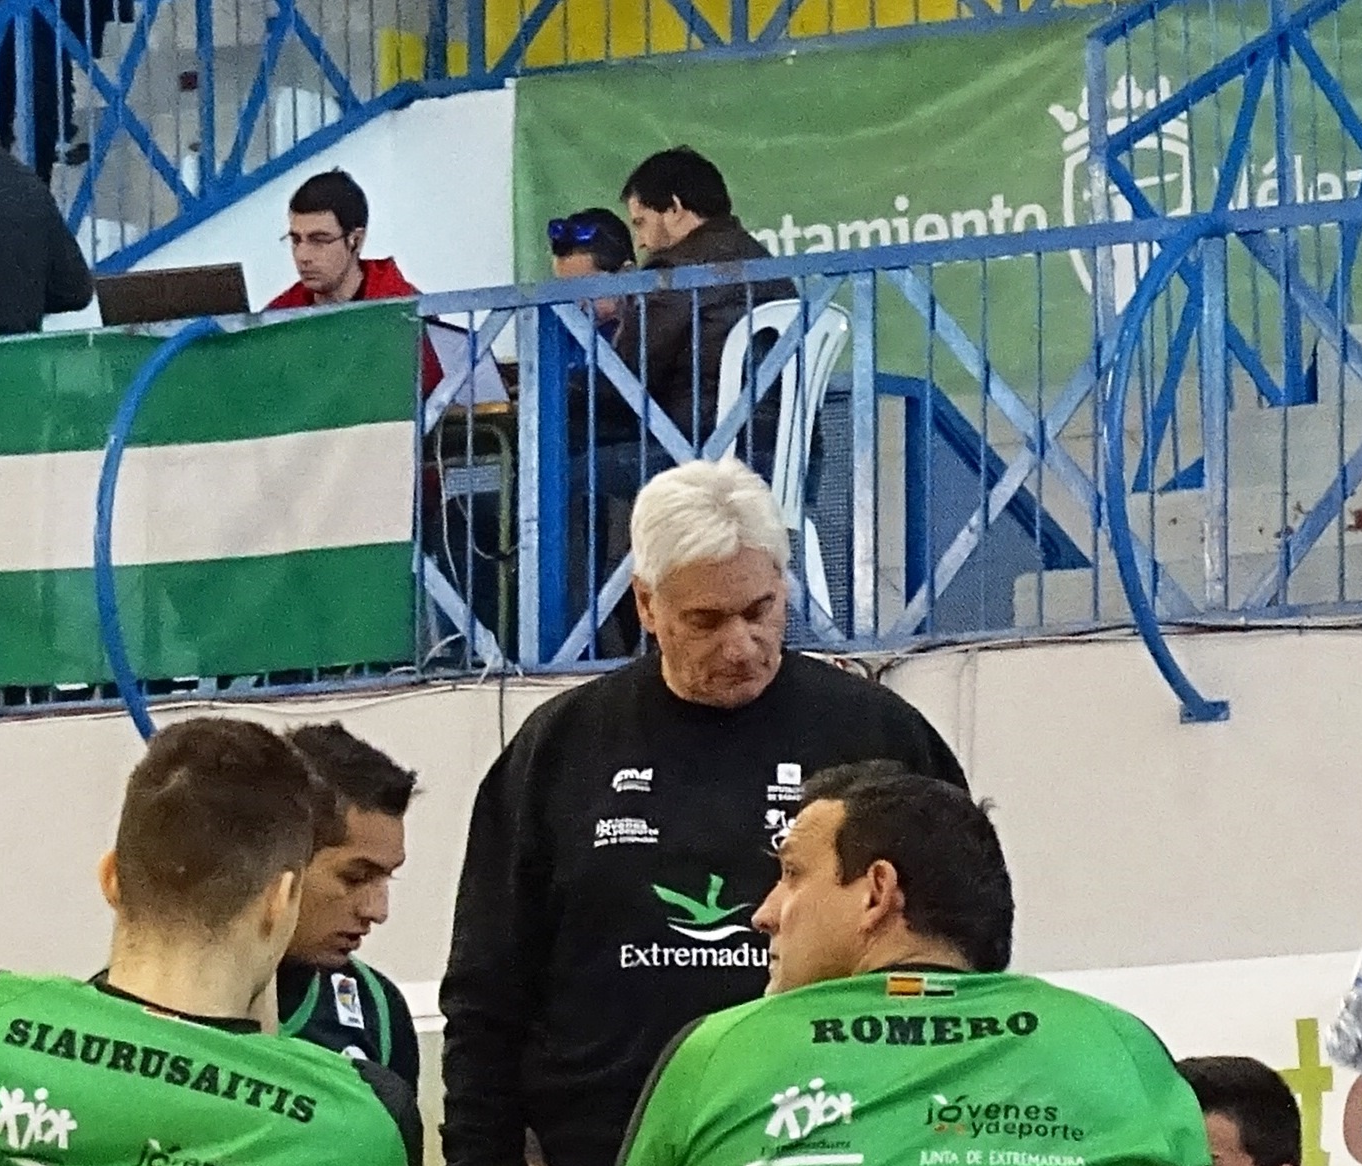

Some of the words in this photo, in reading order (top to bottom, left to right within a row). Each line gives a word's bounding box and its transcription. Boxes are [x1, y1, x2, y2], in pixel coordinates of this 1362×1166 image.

[810, 1011, 1039, 1046] ROMERO
[3, 1017, 318, 1125] SIAURUSAITIS
[923, 1094, 1059, 1125] jóvenes
[970, 1120, 1085, 1142] ydeporte
[920, 1151, 959, 1166] JUNTA
[966, 1151, 983, 1166] DE
